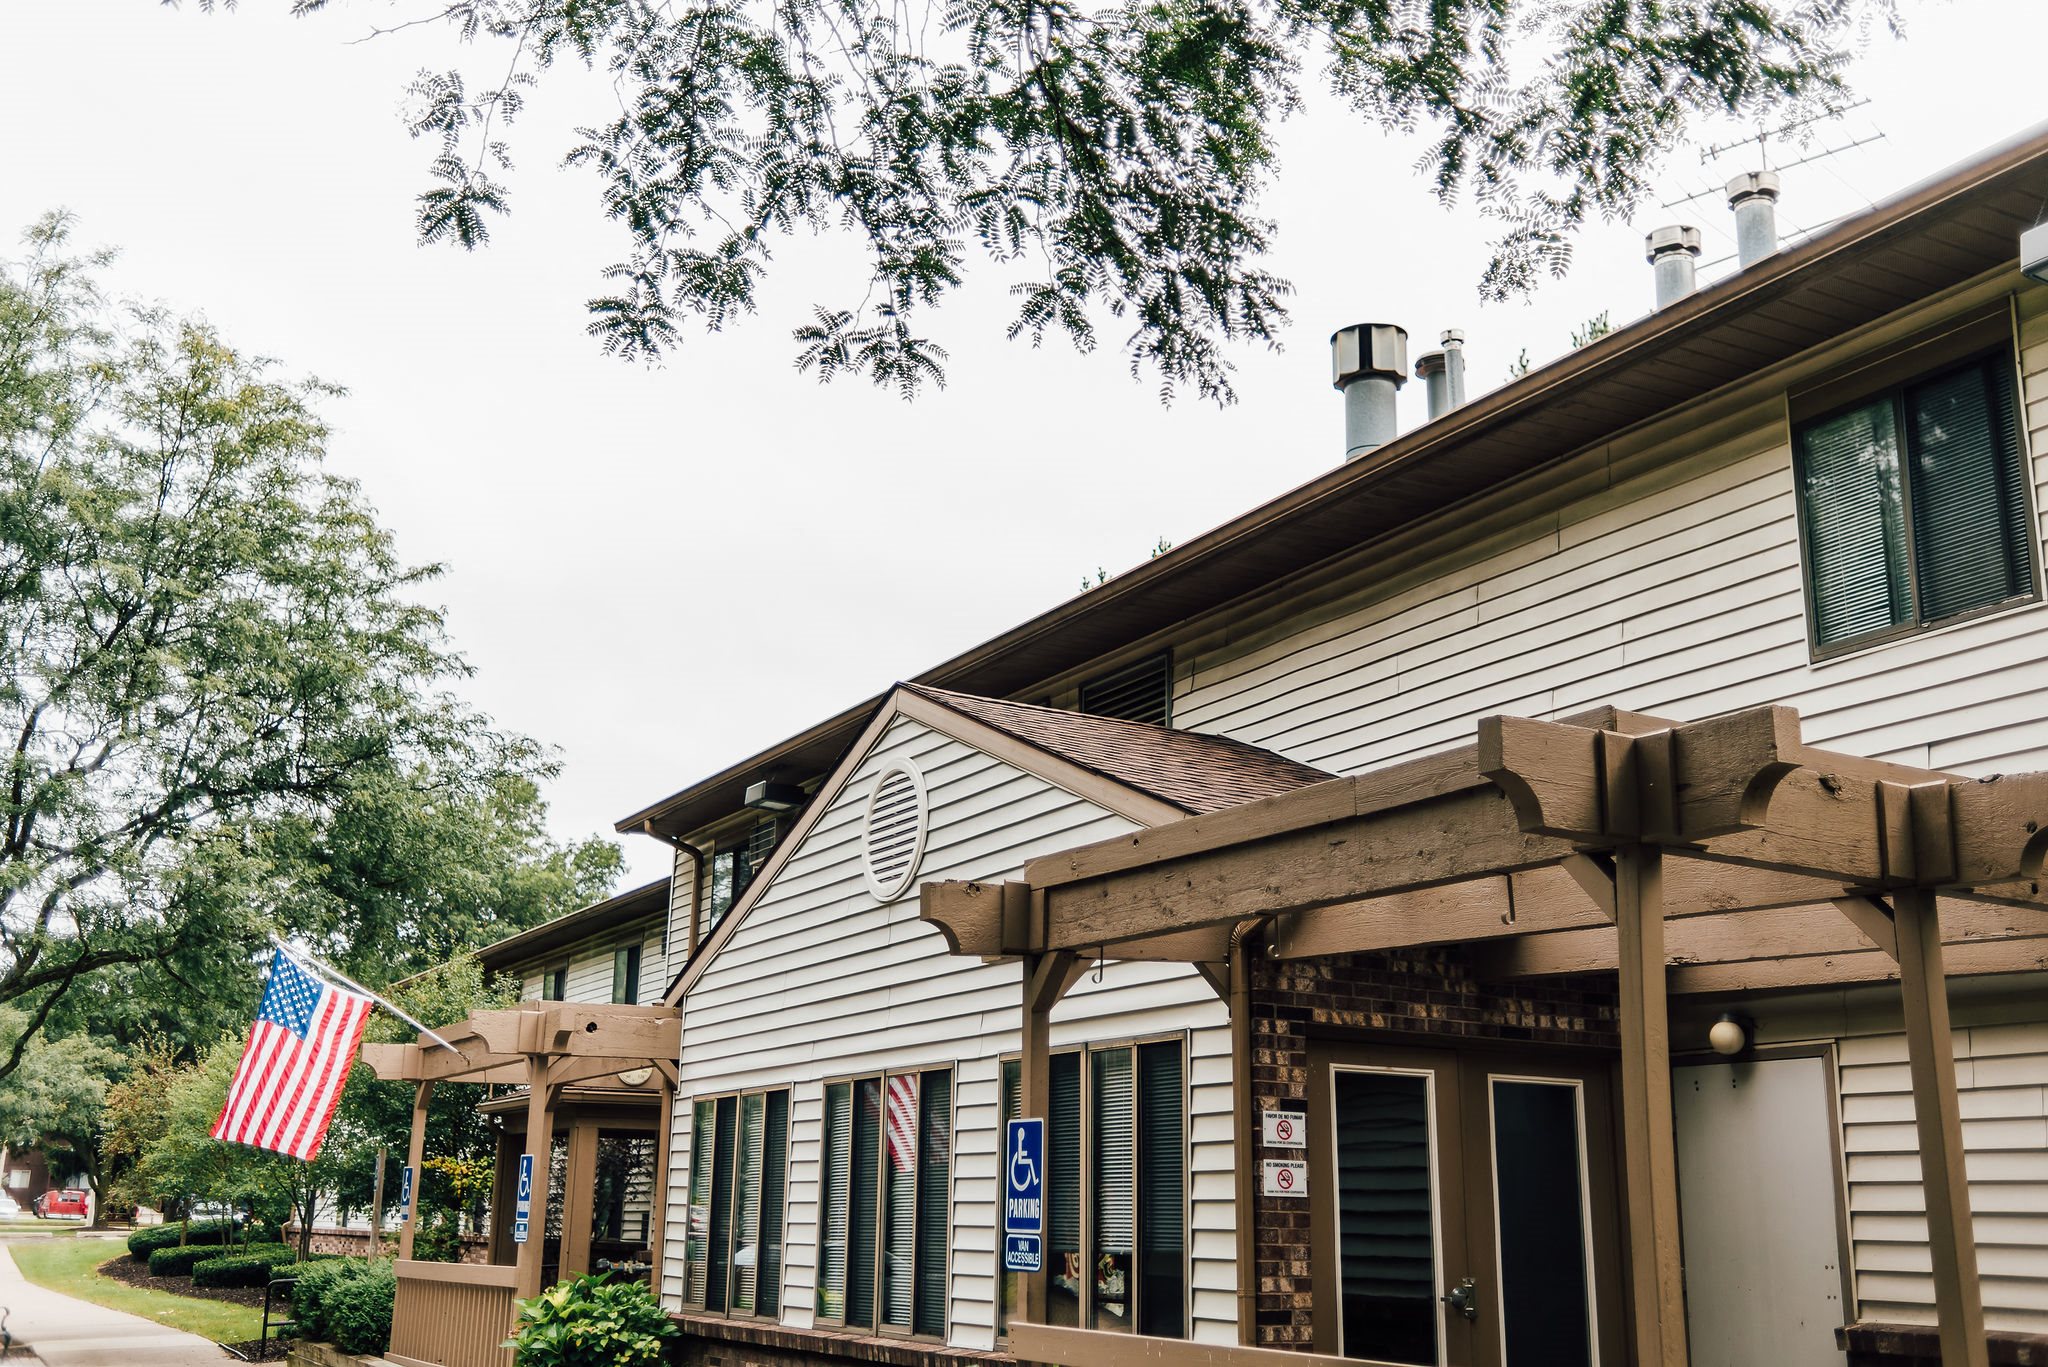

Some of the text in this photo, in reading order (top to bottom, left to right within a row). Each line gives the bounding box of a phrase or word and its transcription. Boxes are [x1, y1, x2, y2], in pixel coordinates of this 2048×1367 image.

[1008, 1198, 1040, 1219] PARKING
[1018, 1240, 1030, 1252] VAN
[1008, 1251, 1039, 1265] ACCESSIBLE
